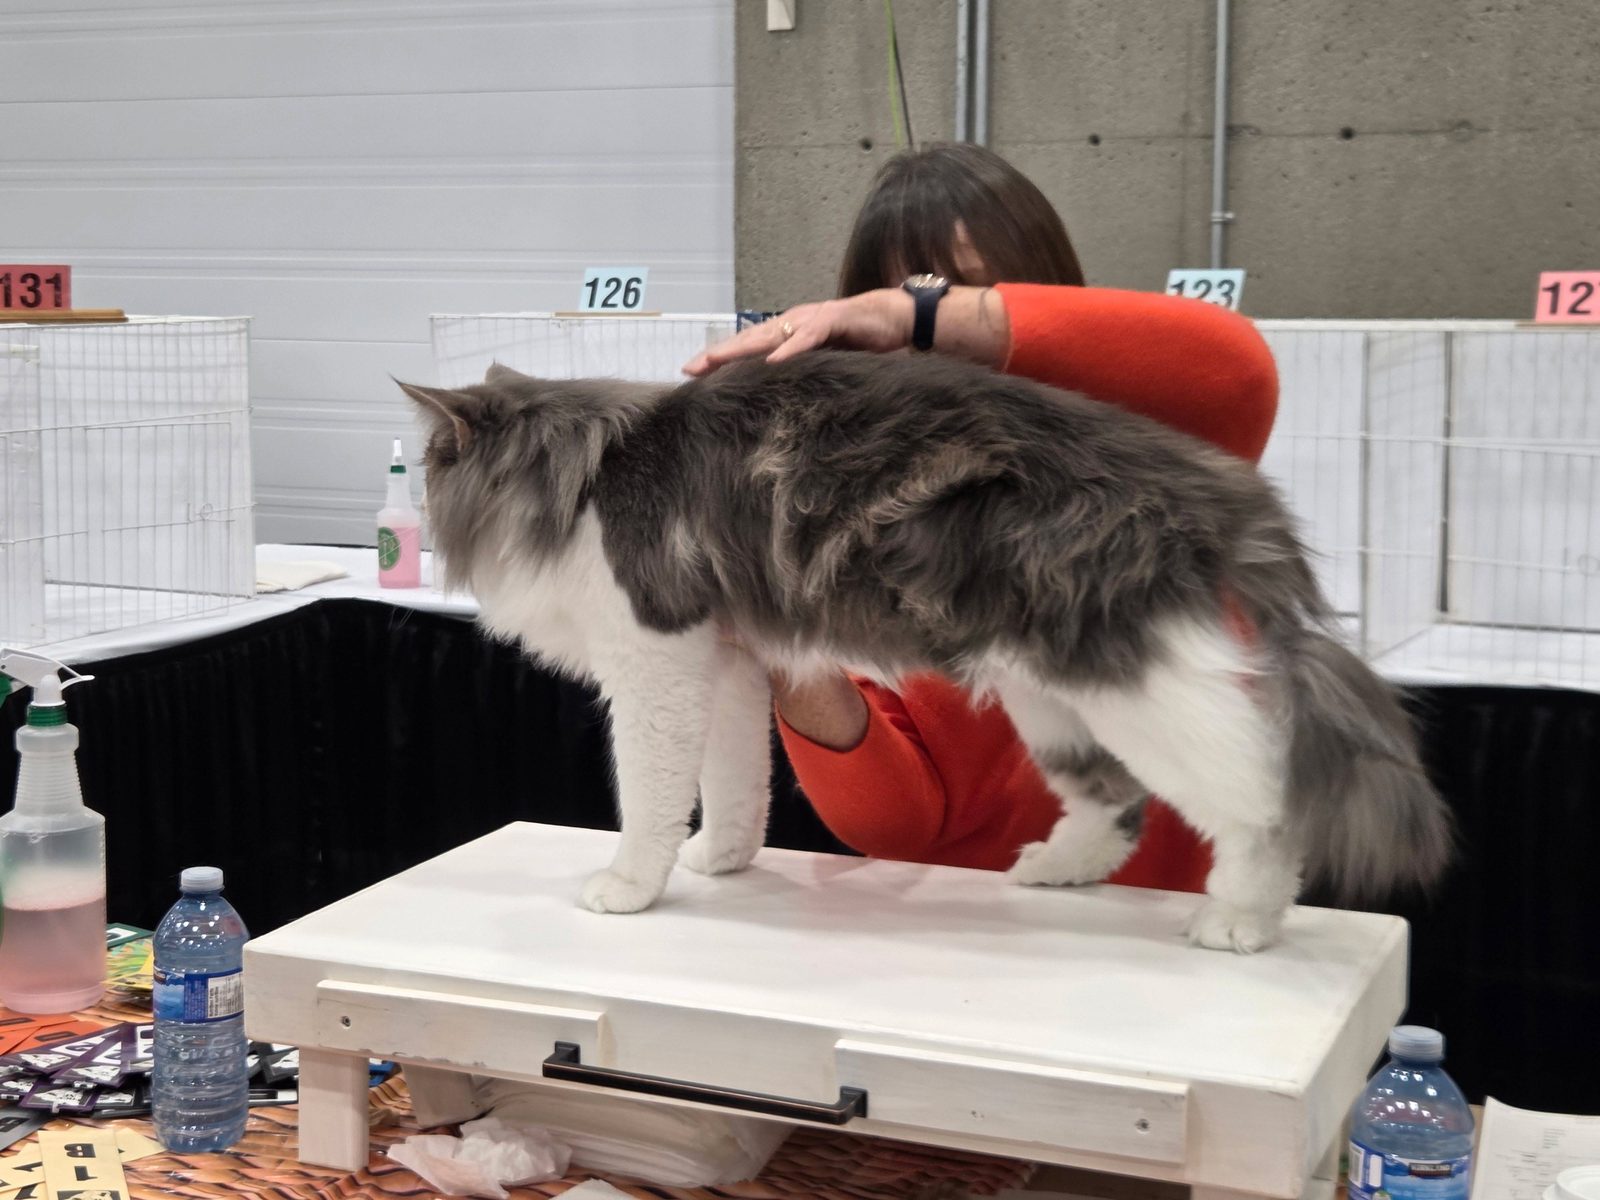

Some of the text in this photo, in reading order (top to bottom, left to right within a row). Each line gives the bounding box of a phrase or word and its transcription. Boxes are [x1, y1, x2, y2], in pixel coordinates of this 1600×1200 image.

[0, 272, 62, 308] 131
[585, 277, 643, 309] 126
[1542, 281, 1600, 315] 12
